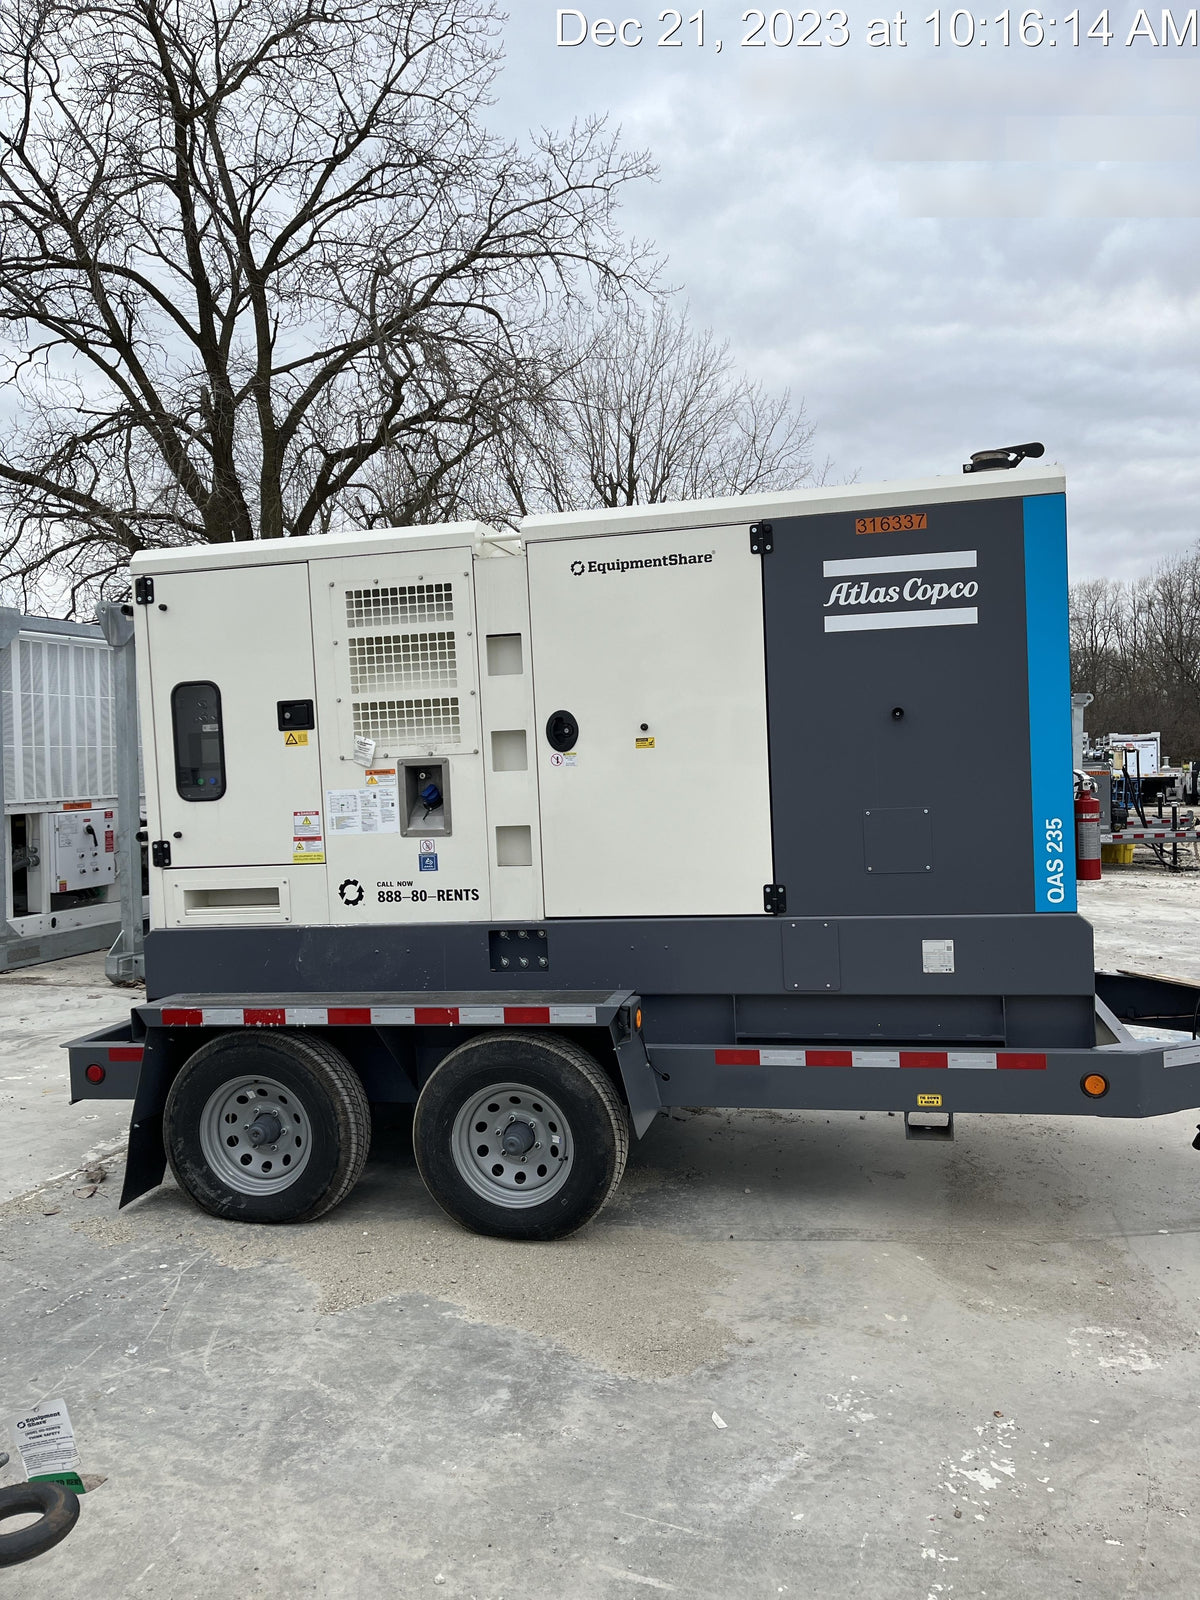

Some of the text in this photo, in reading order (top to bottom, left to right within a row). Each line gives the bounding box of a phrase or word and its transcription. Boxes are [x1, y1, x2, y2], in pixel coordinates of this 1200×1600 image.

[857, 513, 925, 533] 316337
[587, 552, 714, 575] EquipmentShare
[823, 577, 979, 607] Atlas Copco
[1046, 817, 1065, 904] QAS 235
[25, 1411, 61, 1423] Equipment
[27, 1419, 47, 1428] Share
